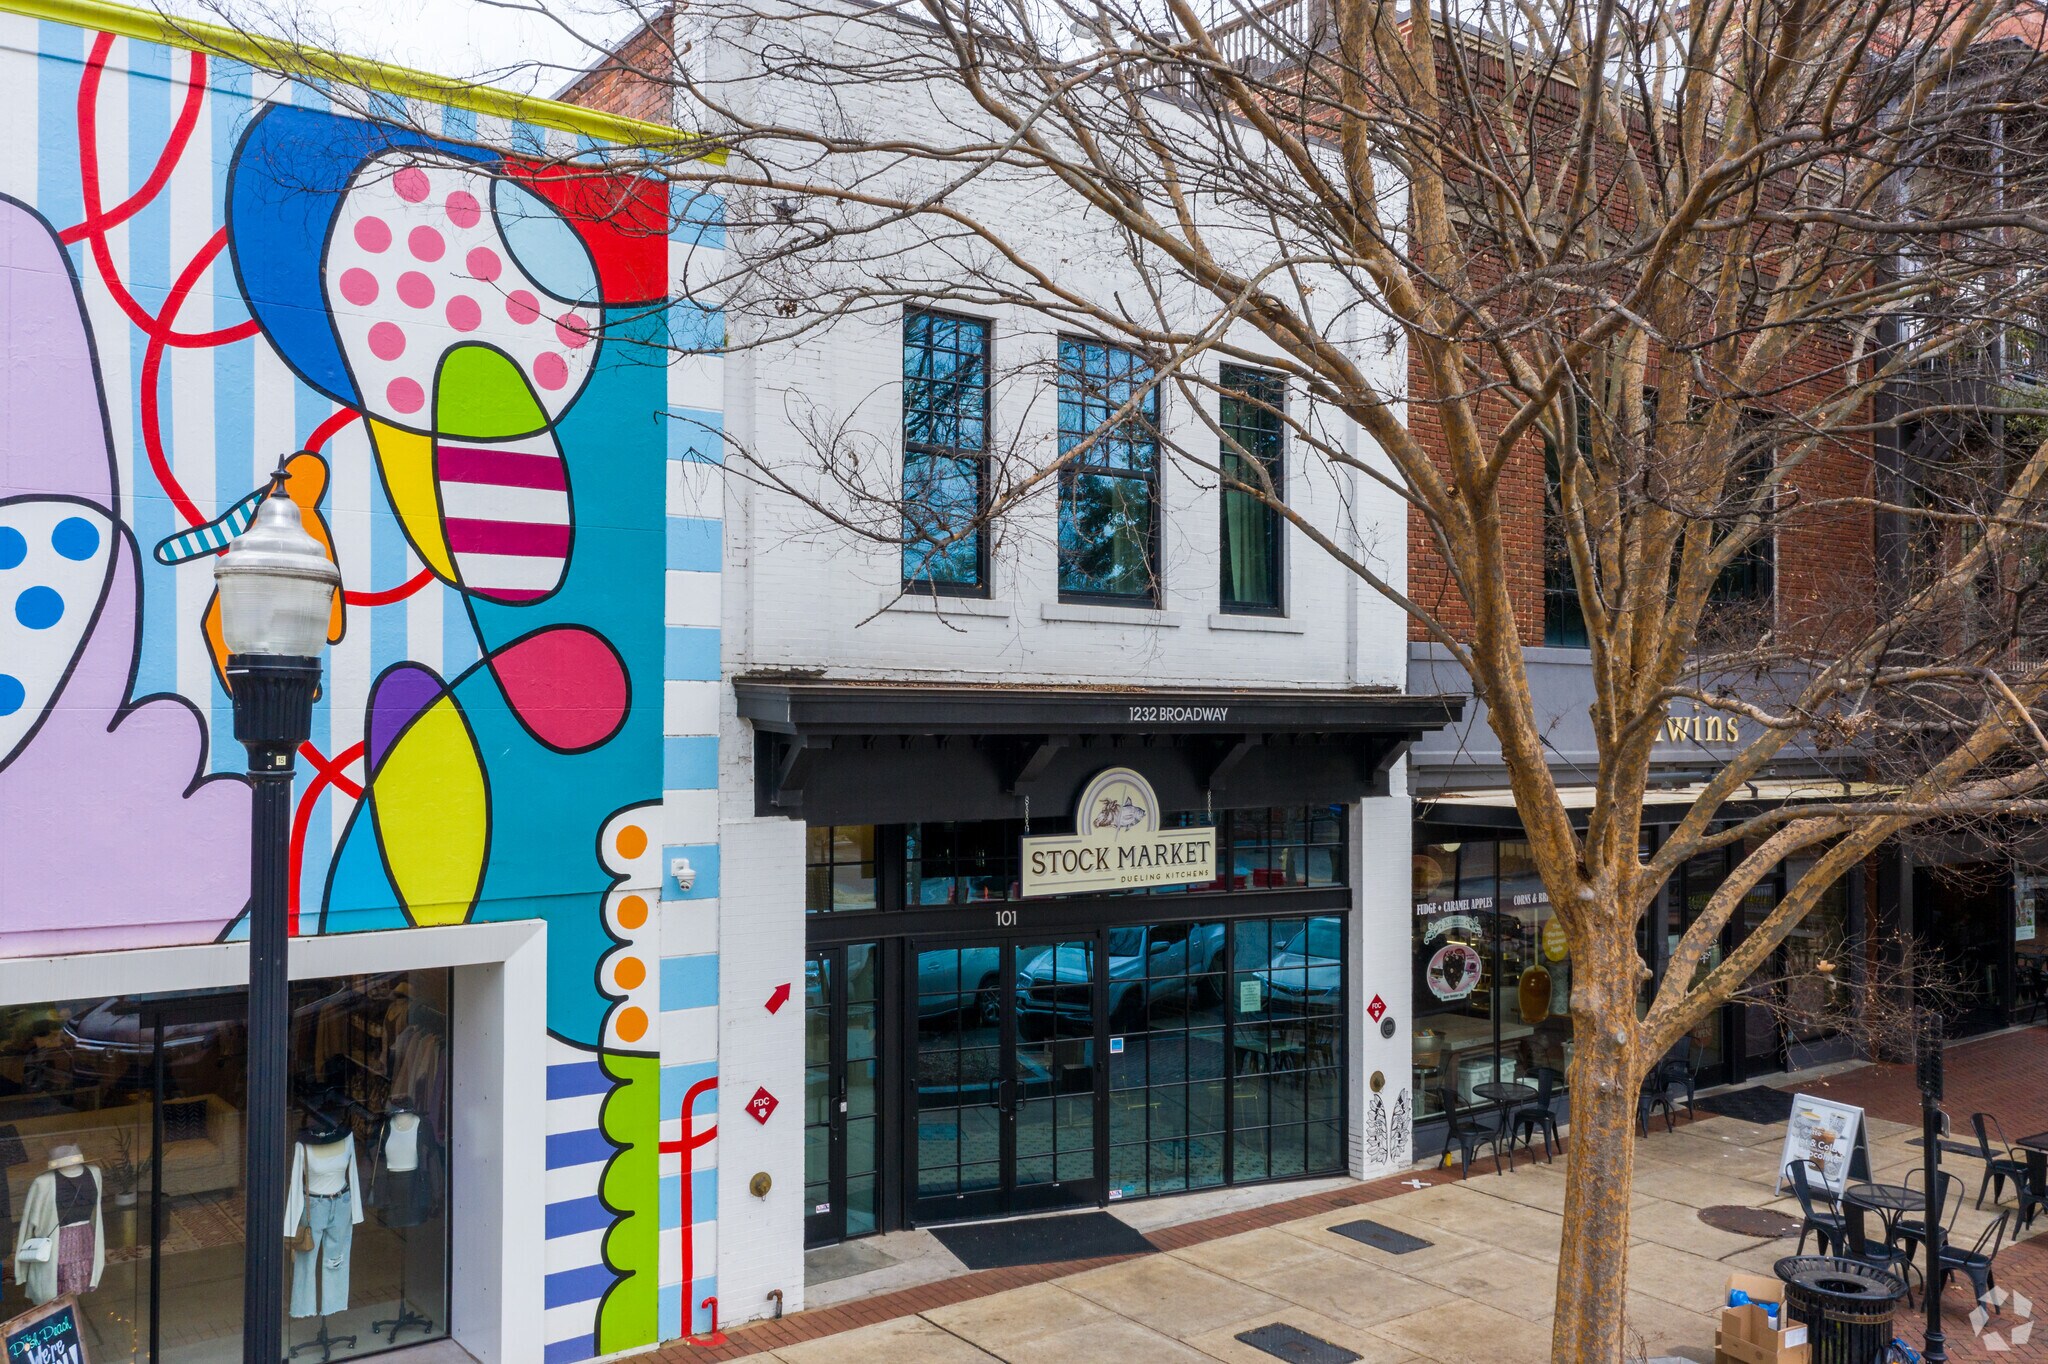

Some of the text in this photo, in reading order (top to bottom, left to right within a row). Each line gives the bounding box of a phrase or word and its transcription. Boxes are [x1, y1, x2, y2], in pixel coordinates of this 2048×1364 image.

[1129, 706, 1228, 721] 1232 BROADWAY
[1655, 715, 1739, 742] wins
[1031, 840, 1211, 876] STOCK MARKET
[1120, 869, 1209, 883] DUELING KITCHENS
[1416, 897, 1493, 915] FUDGE CARAMEL APPLES
[1513, 893, 1531, 906] CORNS
[1531, 893, 1538, 904] &
[995, 910, 1017, 926] 101
[753, 1096, 770, 1108] FDC
[1810, 1139, 1817, 1148] &
